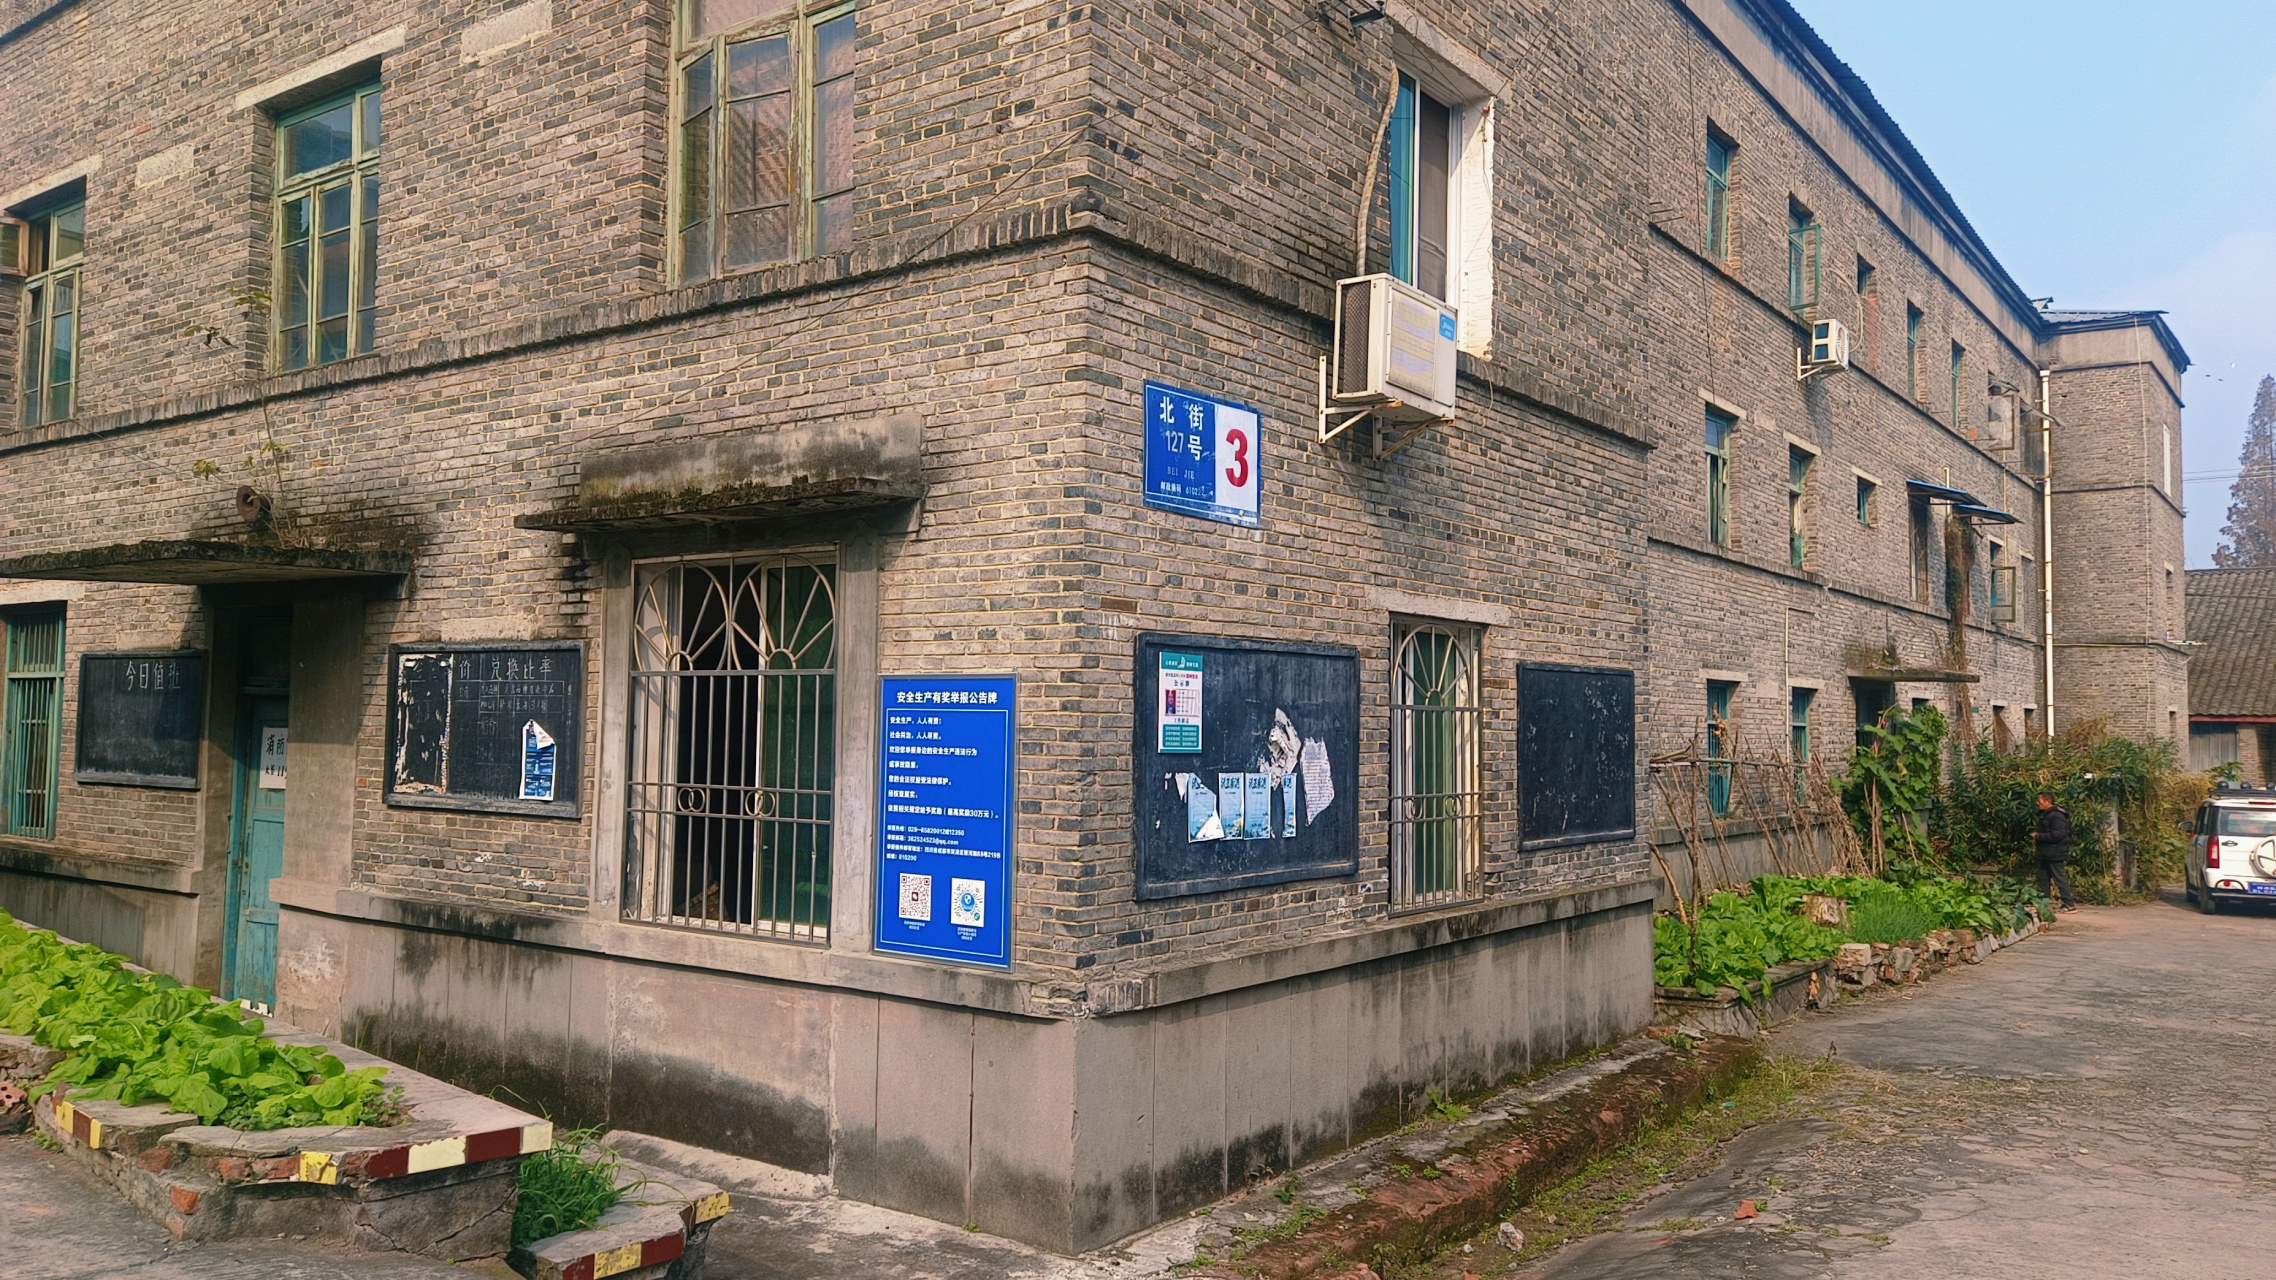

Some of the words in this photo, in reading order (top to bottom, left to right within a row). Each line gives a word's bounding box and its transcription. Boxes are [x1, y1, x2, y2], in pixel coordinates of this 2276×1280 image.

[1159, 396, 1204, 431] 北街
[1165, 430, 1203, 461] 127号
[1225, 428, 1249, 488] 3
[1167, 466, 1179, 477] BEI
[1183, 469, 1195, 480] JIE
[125, 660, 180, 691] 今日值班
[491, 656, 553, 681] 兑换比率
[896, 691, 998, 705] 安全生产有奖举报公告牌
[266, 734, 288, 756] 消防
